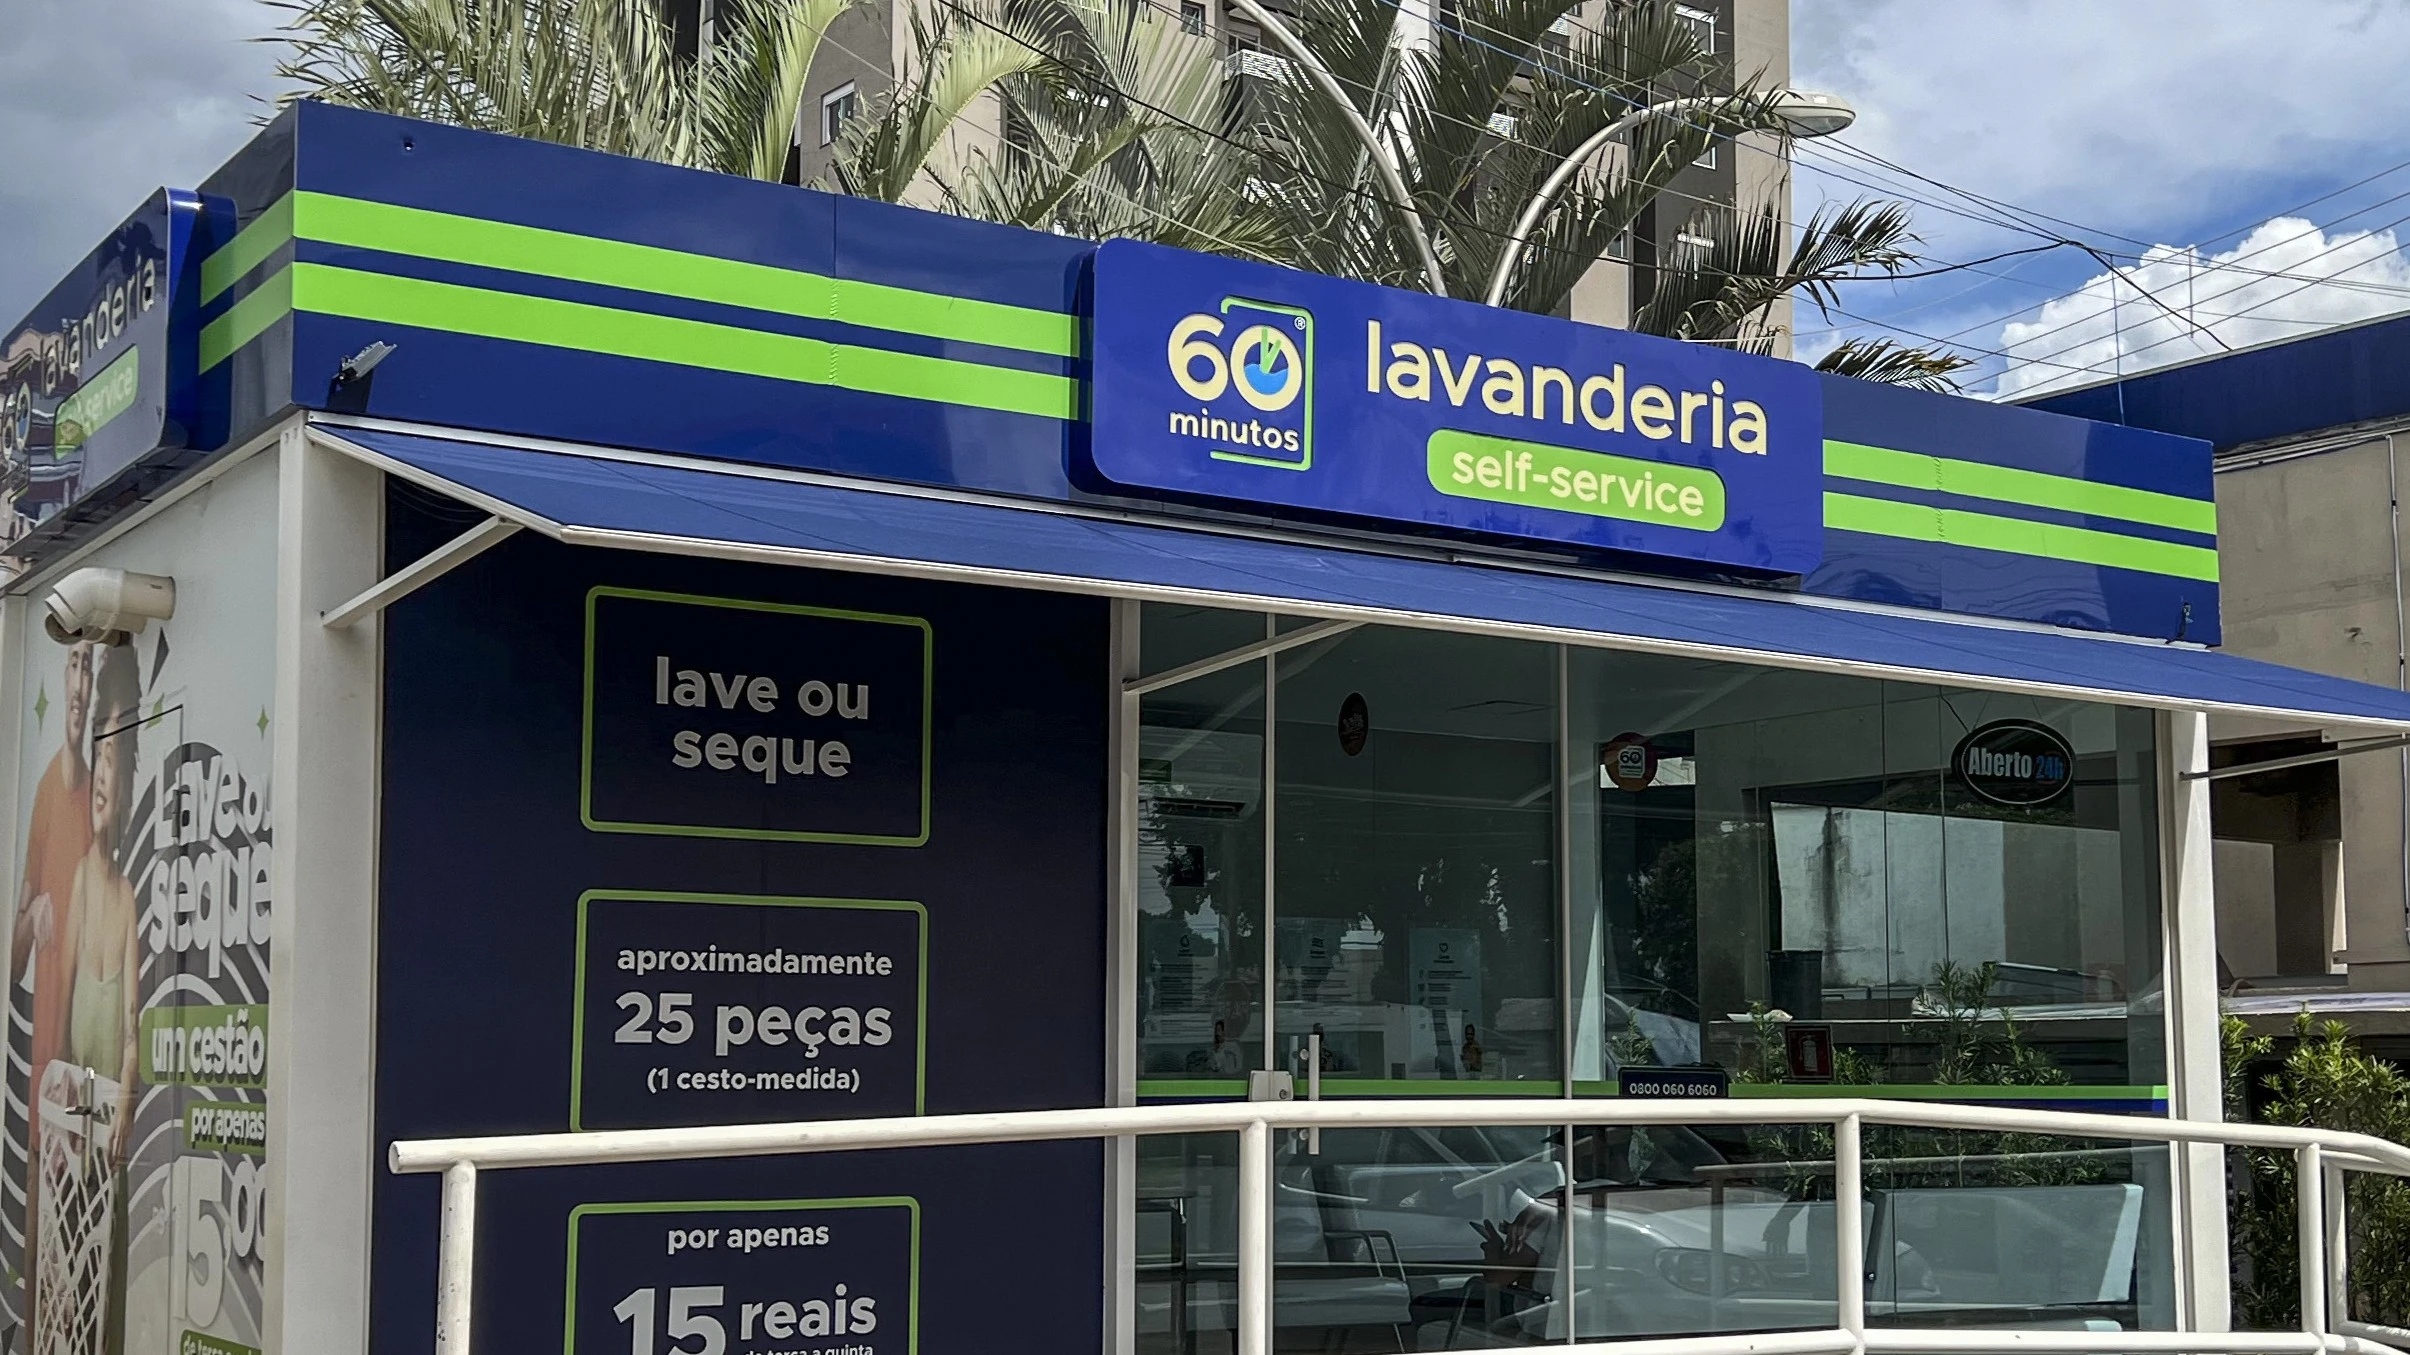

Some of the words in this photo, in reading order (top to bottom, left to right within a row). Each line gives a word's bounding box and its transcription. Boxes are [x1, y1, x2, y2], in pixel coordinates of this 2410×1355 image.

[42, 254, 156, 396] lavanderia
[1168, 313, 1303, 412] 60
[1367, 319, 1768, 456] lavanderia
[1169, 407, 1300, 452] minutos
[1451, 449, 1705, 517] self-service
[655, 655, 779, 713] lave
[797, 679, 869, 720] ou
[671, 729, 851, 784] seque
[1620, 750, 1641, 764] 60
[1968, 746, 2033, 779] Aberto
[2035, 754, 2065, 780] 24h
[154, 752, 240, 850] Lave
[148, 841, 271, 979] seque
[617, 944, 893, 976] aproximadamente
[152, 1026, 186, 1073] um
[189, 1008, 265, 1076] cestão
[614, 991, 694, 1045] 25
[715, 1005, 893, 1059] peças
[647, 1067, 669, 1094] (1
[676, 1066, 860, 1094] cesto-medida)
[1629, 1082, 1660, 1095] 0800
[1662, 1083, 1685, 1096] 060
[1687, 1083, 1717, 1096] 6060
[190, 1107, 215, 1142] por
[215, 1109, 265, 1145] apenas
[667, 1226, 719, 1255] por
[726, 1224, 830, 1253] apenas
[612, 1285, 727, 1355] 15
[740, 1283, 877, 1340] reais
